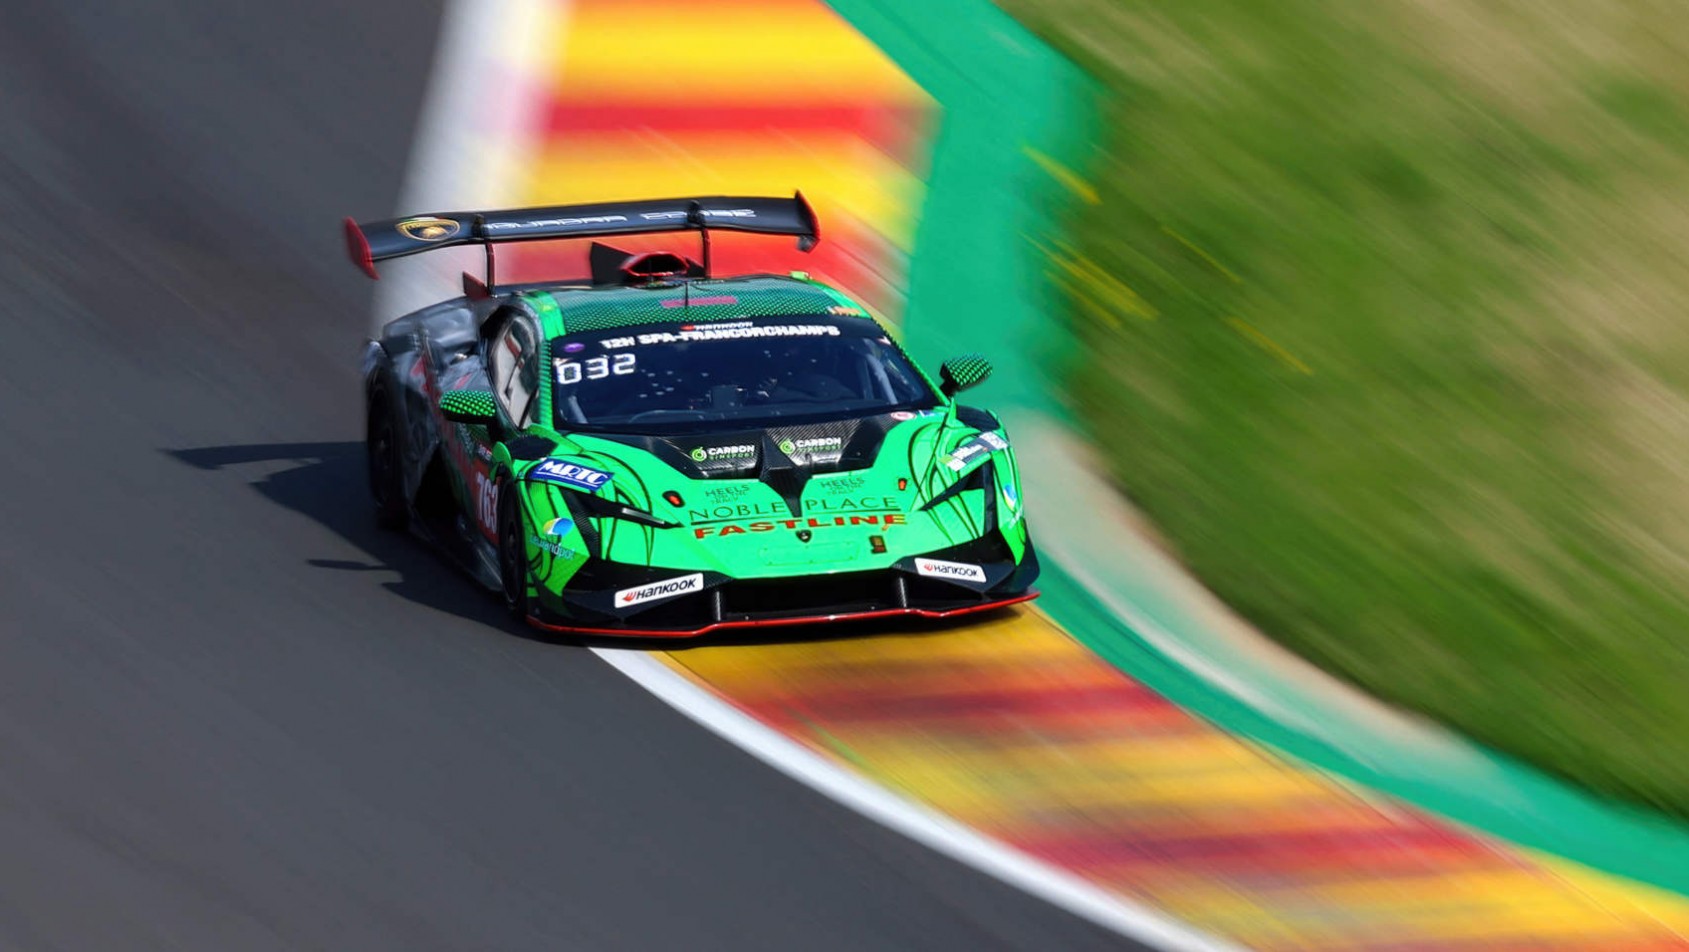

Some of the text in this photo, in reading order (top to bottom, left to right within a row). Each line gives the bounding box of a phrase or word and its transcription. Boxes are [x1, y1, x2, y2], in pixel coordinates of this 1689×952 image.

[600, 325, 841, 349] 12H SPA-FRANCORCHAMPS
[557, 353, 636, 385] 032
[707, 445, 755, 456] CARBON
[795, 437, 842, 449] CARBON
[538, 461, 609, 485] MRTC
[704, 484, 750, 497] HEELS
[476, 471, 498, 535] 763
[688, 496, 900, 521] NOBLE PLACE
[694, 514, 908, 540] FASTLINE
